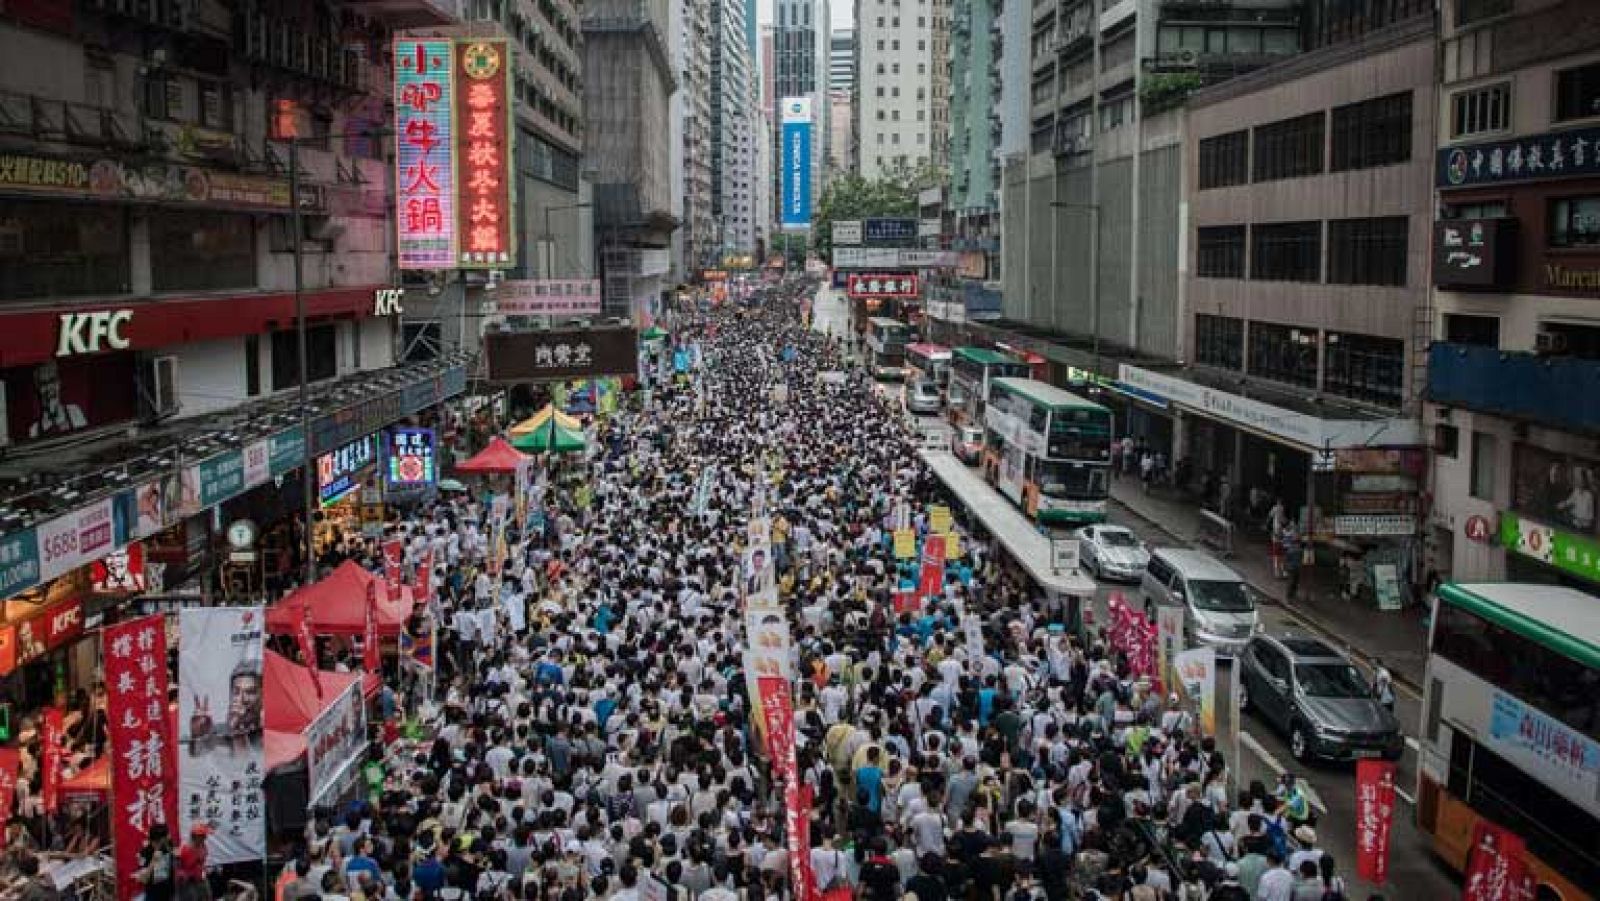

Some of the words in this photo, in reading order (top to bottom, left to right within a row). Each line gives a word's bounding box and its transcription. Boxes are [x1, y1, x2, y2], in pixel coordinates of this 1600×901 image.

[374, 288, 404, 316] KFC
[56, 310, 134, 357] KFC
[52, 605, 80, 634] KFC
